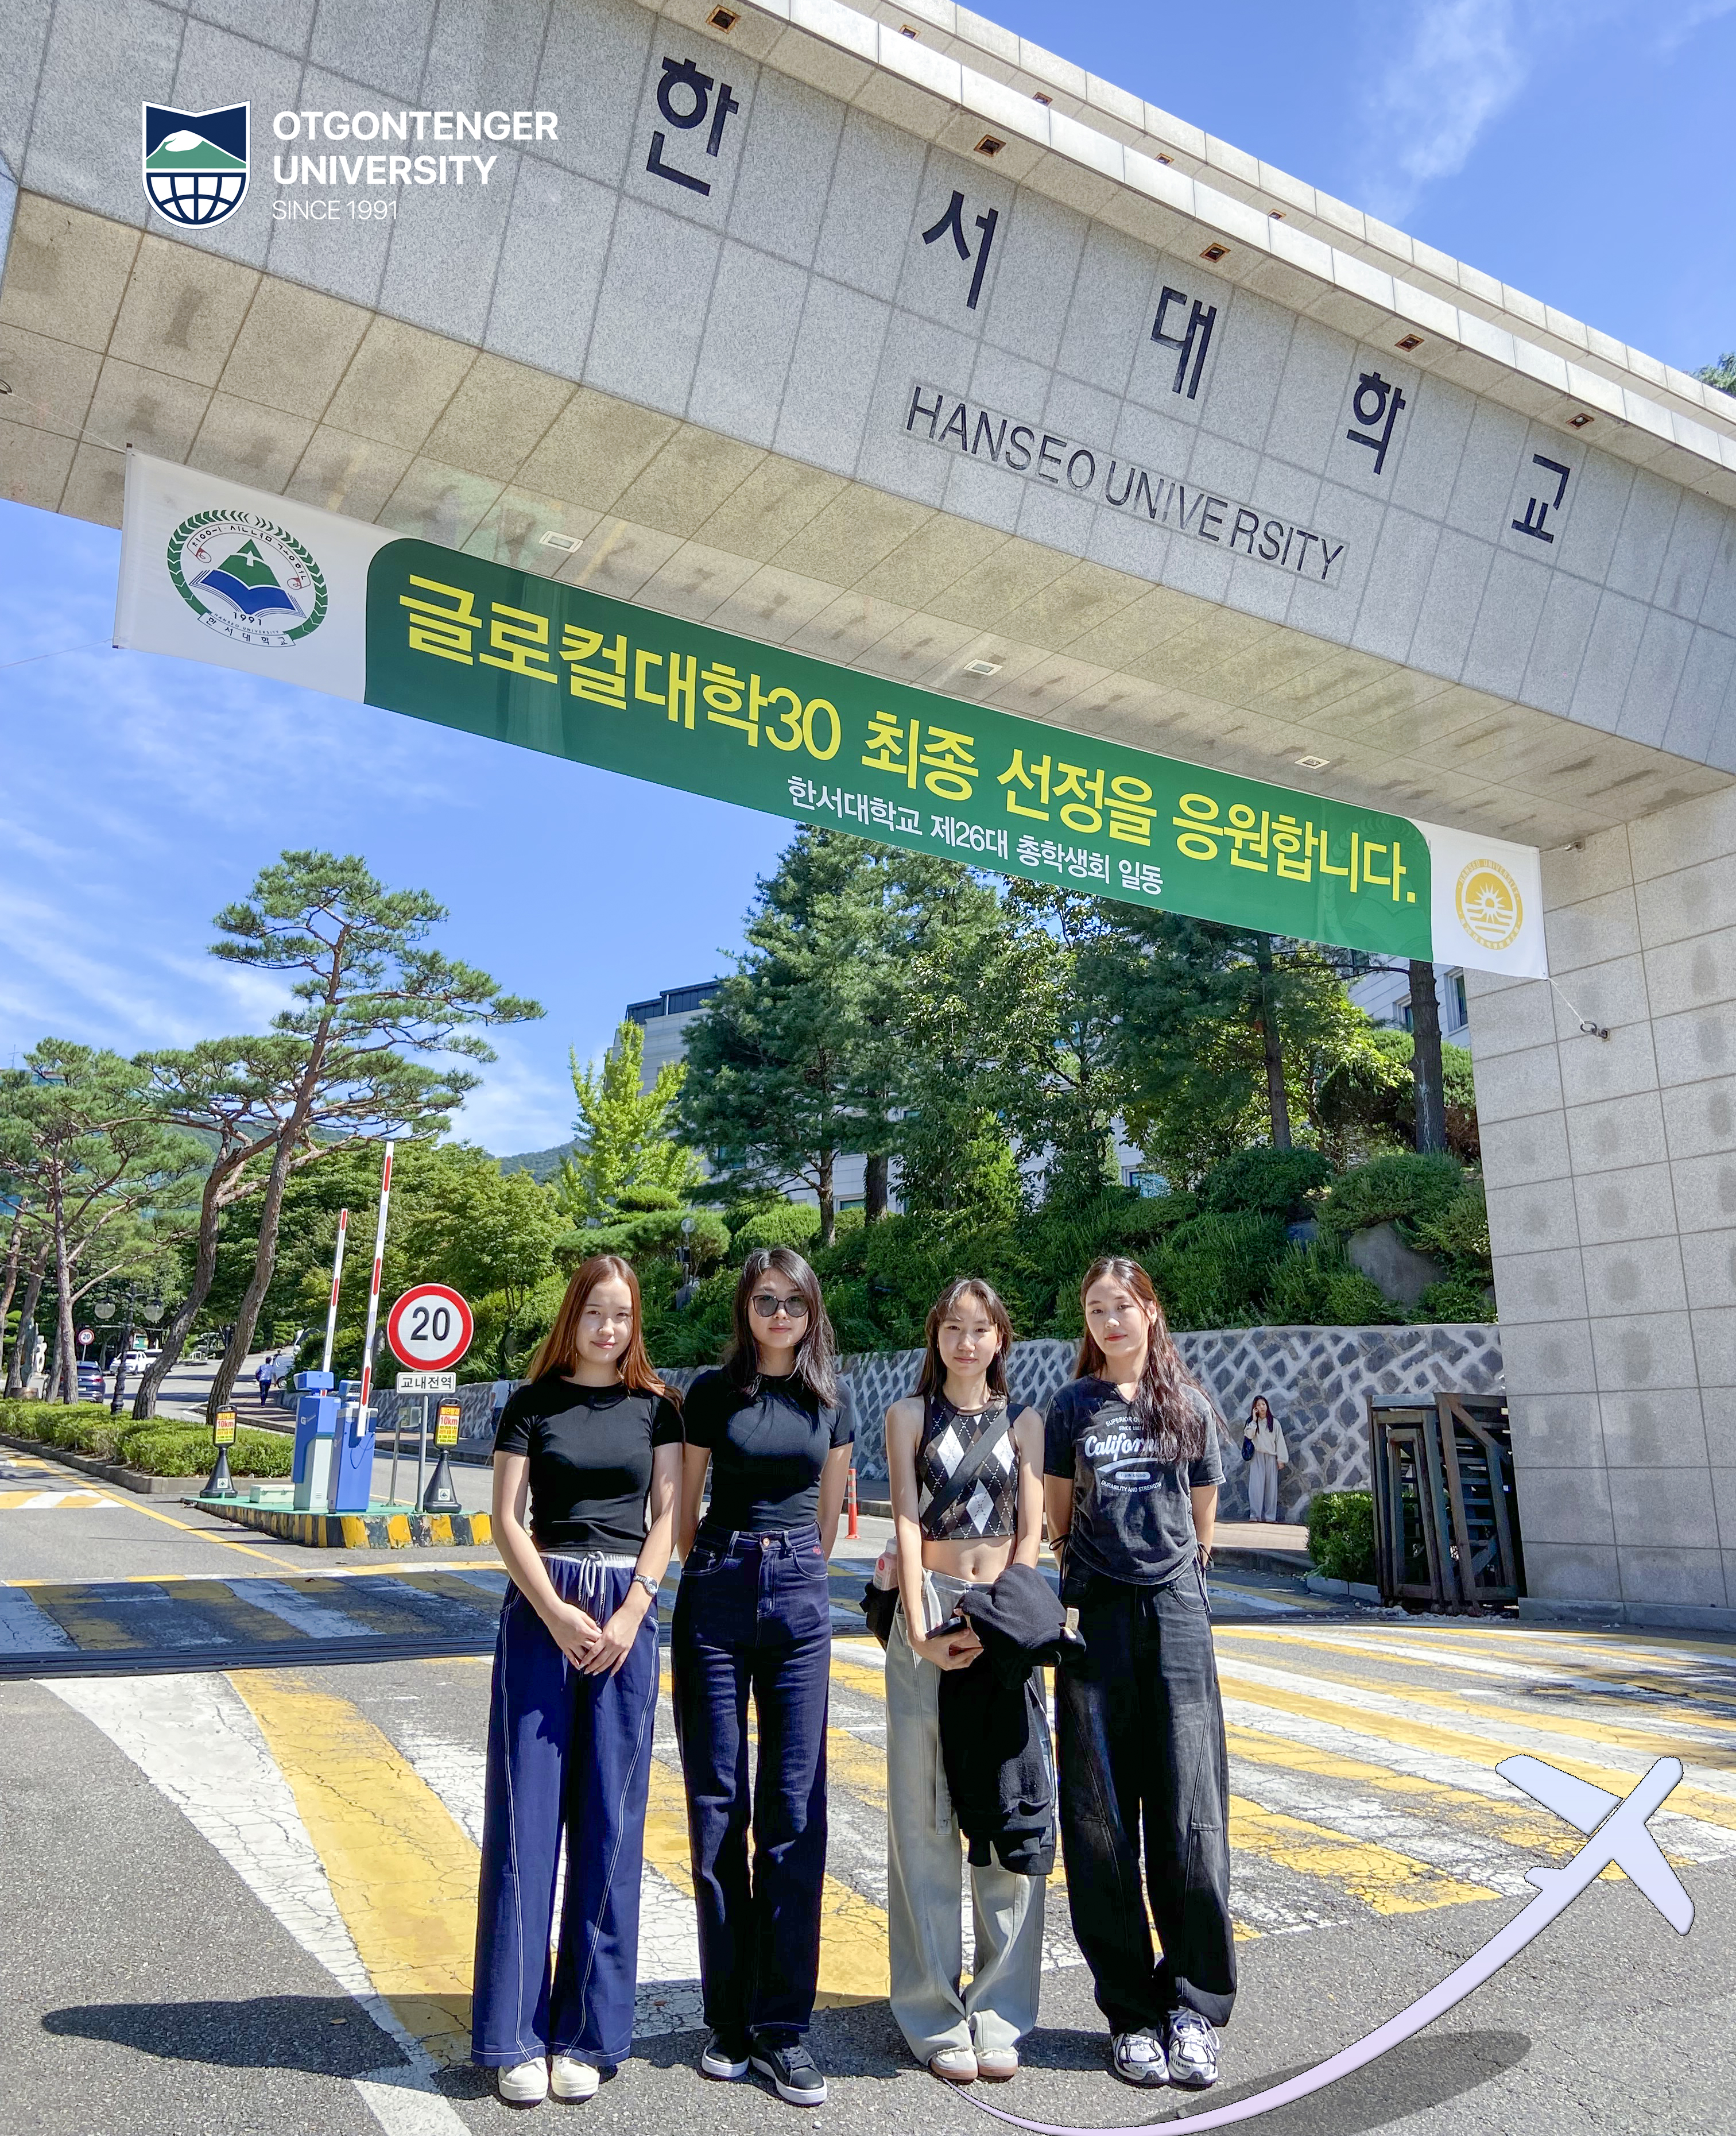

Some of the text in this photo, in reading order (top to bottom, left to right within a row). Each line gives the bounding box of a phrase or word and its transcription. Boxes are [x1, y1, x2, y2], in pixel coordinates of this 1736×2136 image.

[906, 386, 1344, 581] HANSEO UNIVERSITY
[214, 613, 239, 628] HANSEO
[233, 612, 261, 626] 1991
[206, 617, 288, 645] 한서대학교
[399, 574, 1416, 903] 글로컬대학30 최종 선정을 응원합니다.
[787, 775, 1164, 896] 한서대학교 제26대 총학생회 일동
[1459, 860, 1518, 895] HANSEO UNIVERSITY
[410, 1306, 451, 1341] 20
[401, 1376, 452, 1390] 교내전역
[440, 1416, 458, 1425] 10km
[1105, 1416, 1133, 1427] SUPERIOR
[1100, 1480, 1127, 1492] DURABILITY
[1138, 1481, 1162, 1492] STRENGTH
